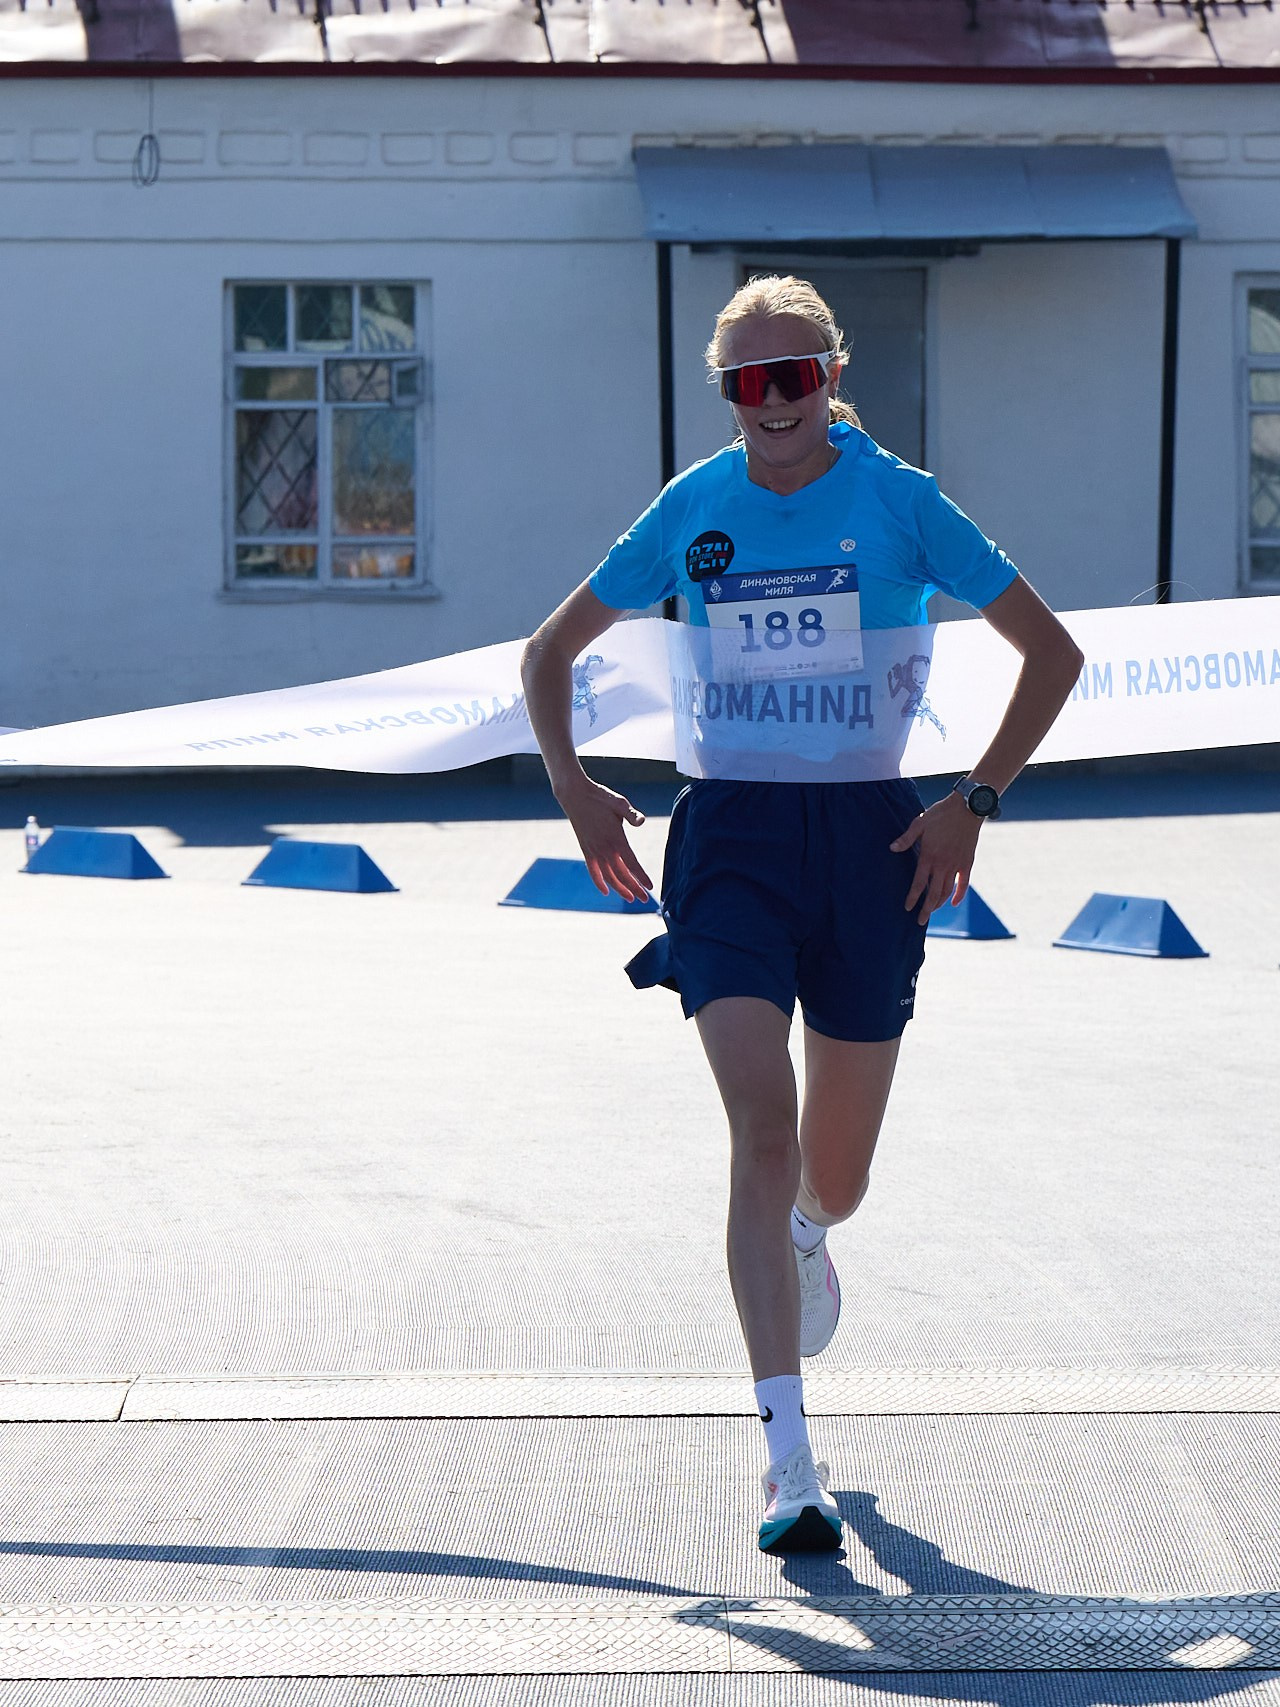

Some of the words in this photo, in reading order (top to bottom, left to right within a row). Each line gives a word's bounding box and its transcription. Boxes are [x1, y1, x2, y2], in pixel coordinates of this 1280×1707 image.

[740, 573, 817, 589] ДИНАМОВСКАЯ
[765, 586, 794, 596] МИЛЯ
[738, 608, 826, 653] 188
